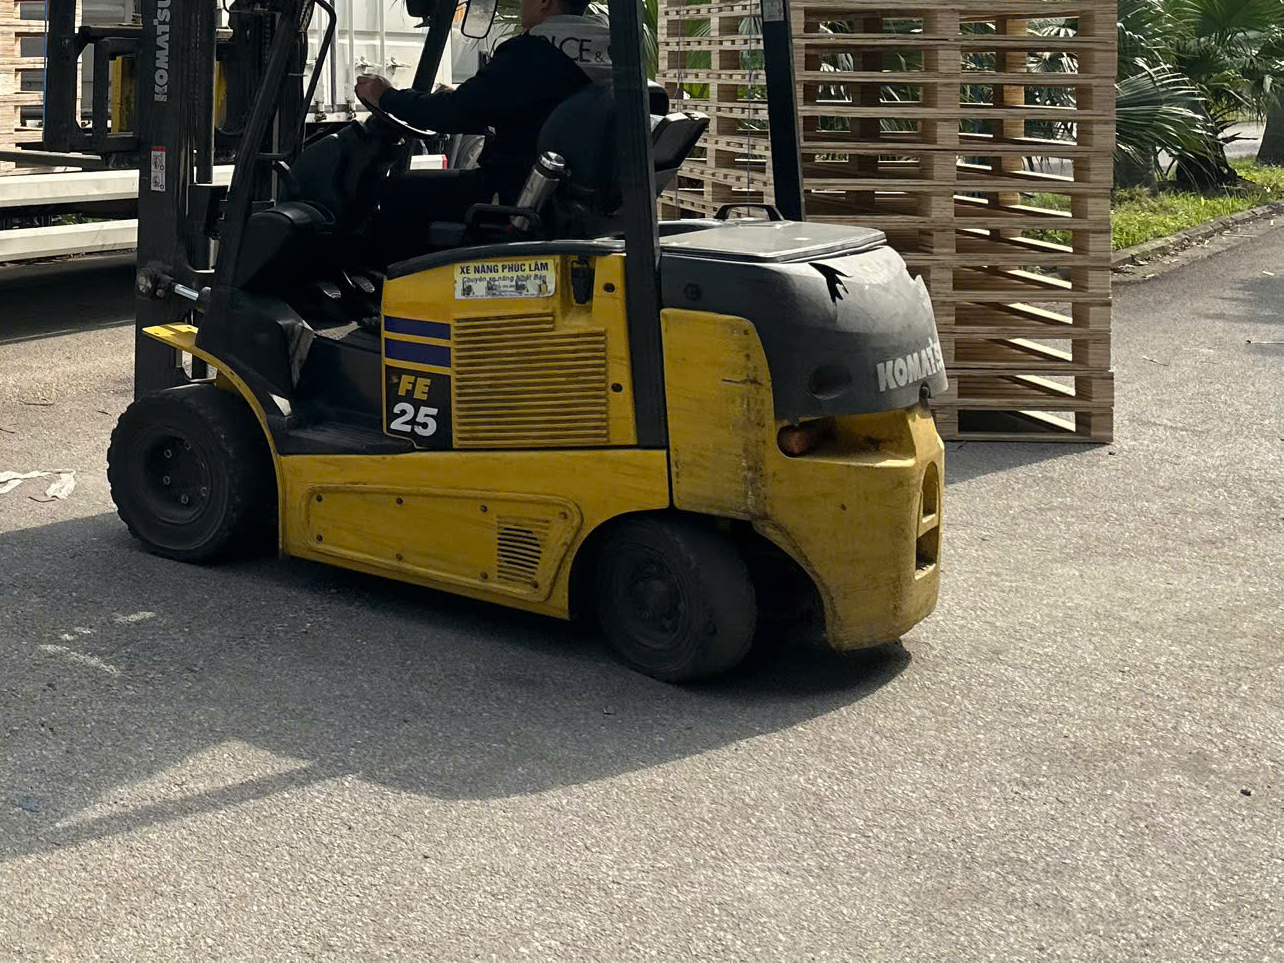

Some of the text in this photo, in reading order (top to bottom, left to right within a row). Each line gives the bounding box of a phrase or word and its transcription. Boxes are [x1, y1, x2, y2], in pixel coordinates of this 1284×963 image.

[460, 265, 471, 275] XE
[877, 337, 944, 392] KOMATS
[398, 374, 431, 400] FE
[390, 402, 438, 437] 25
